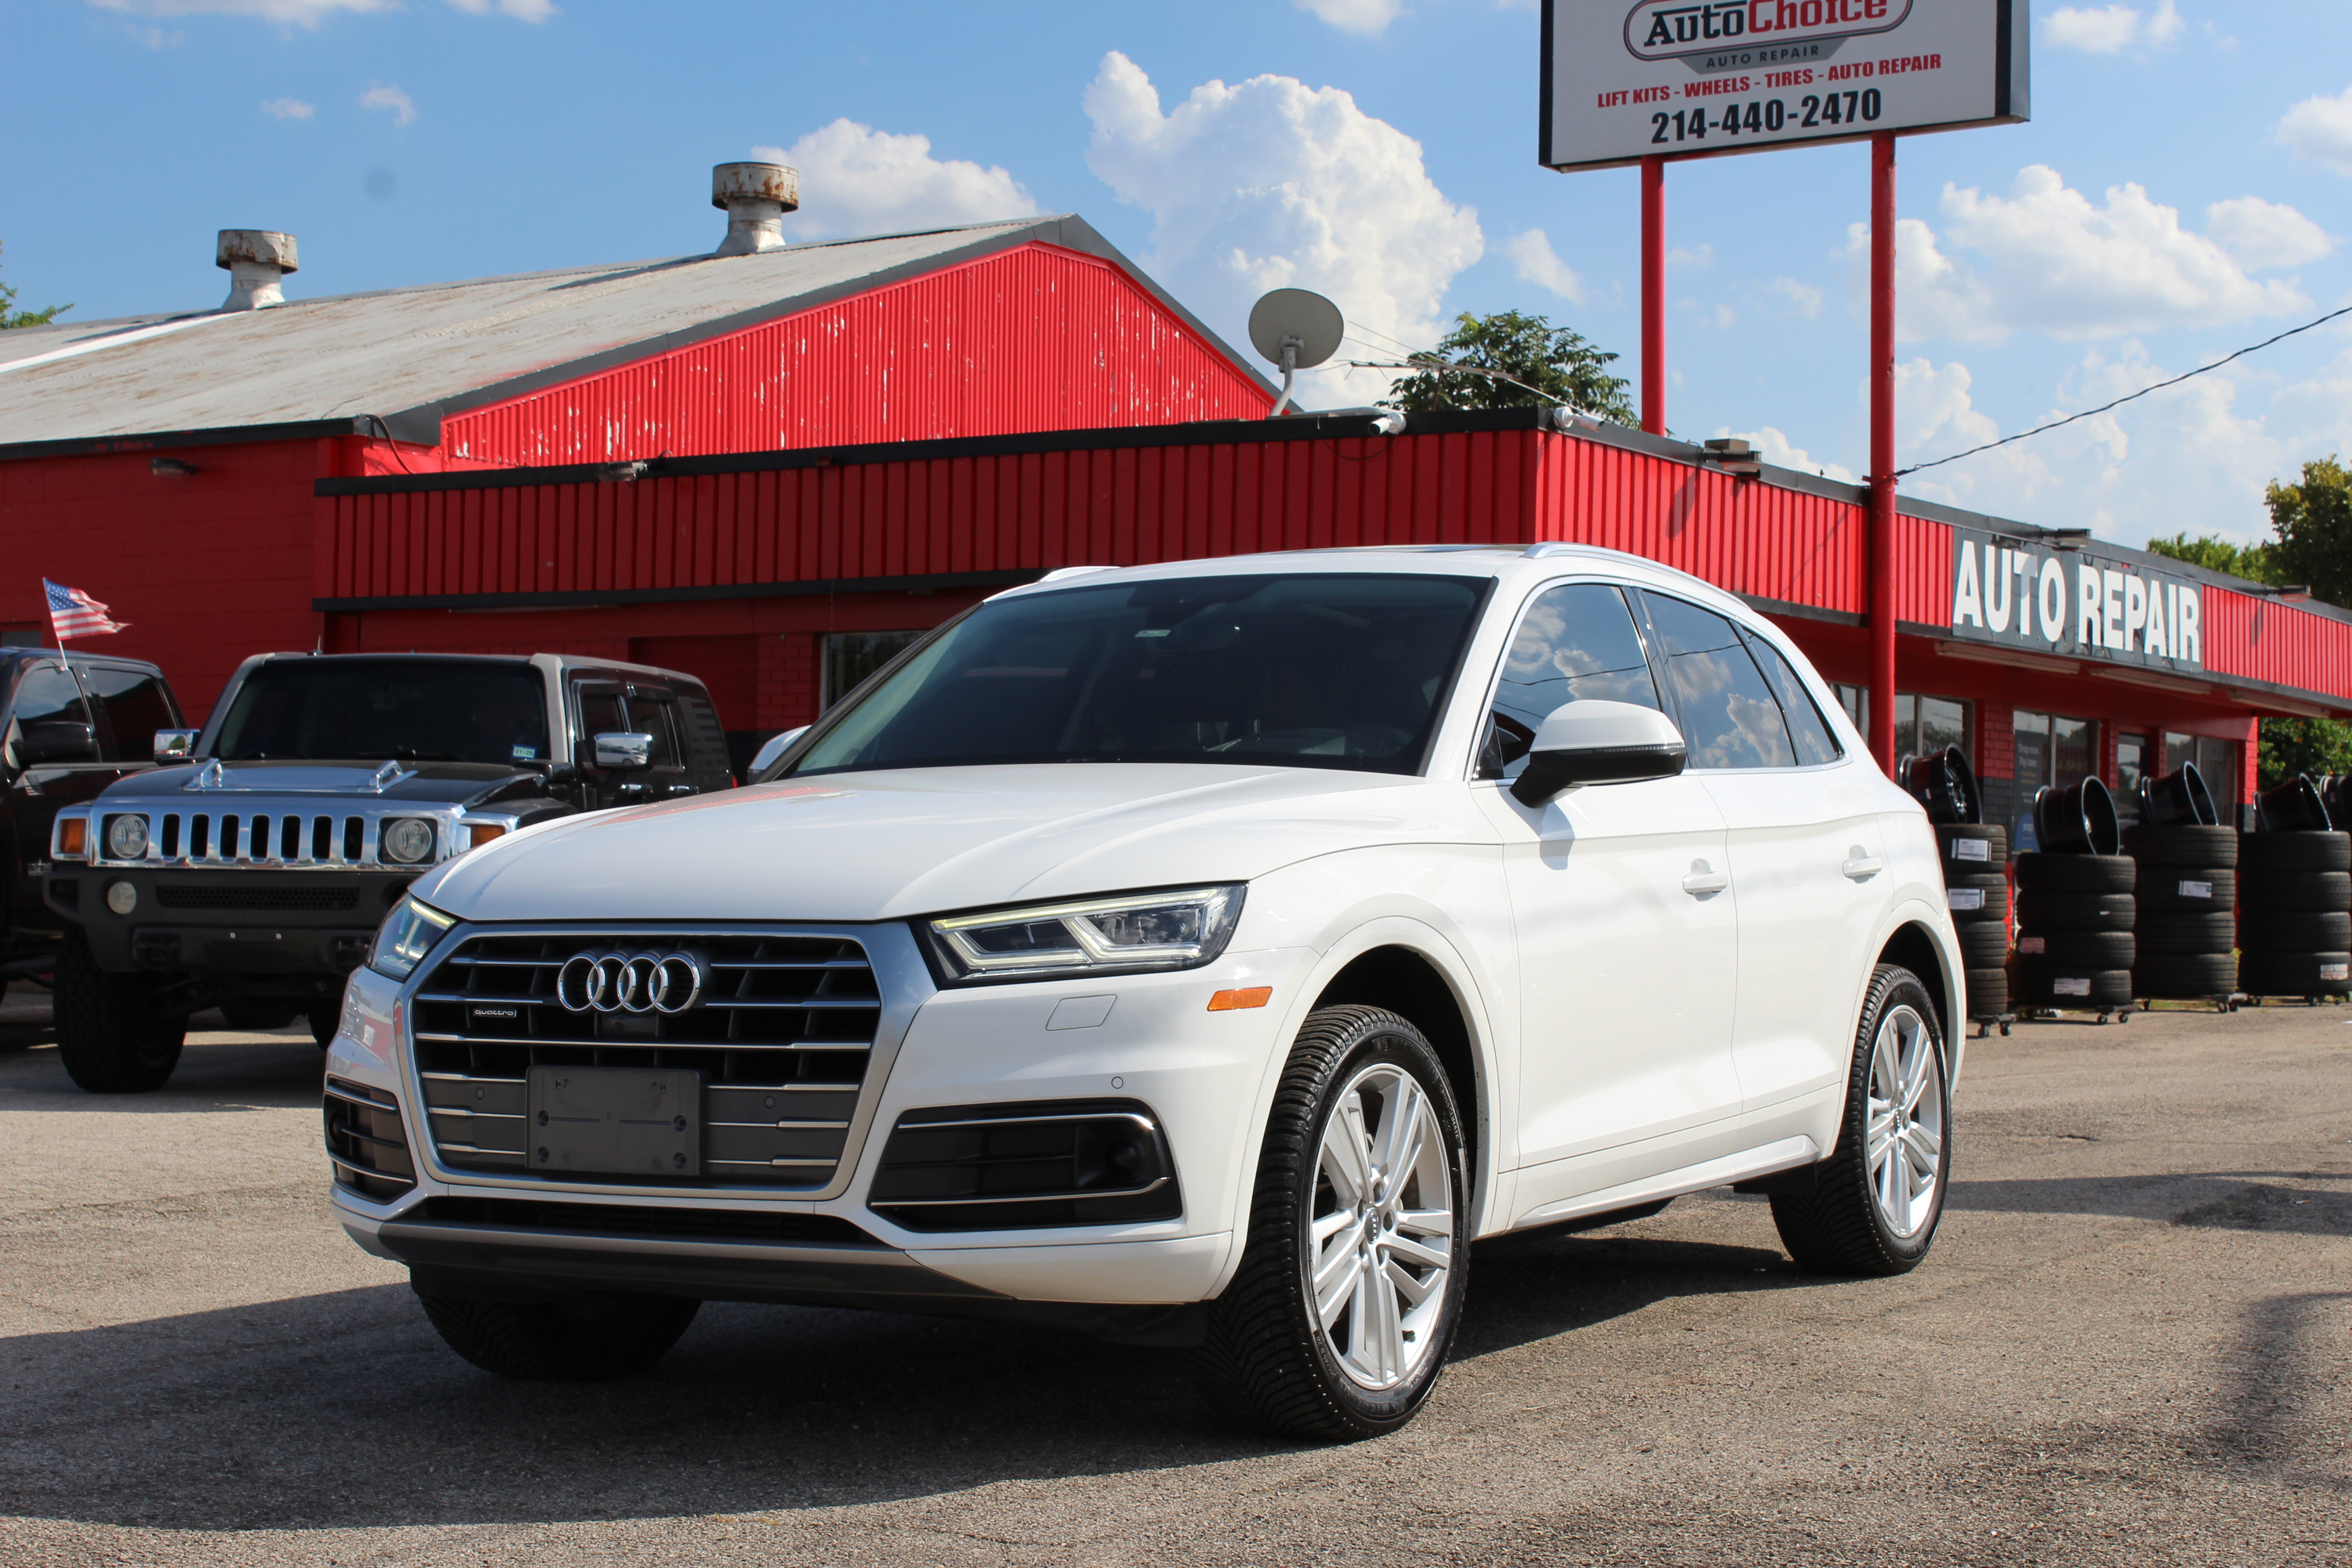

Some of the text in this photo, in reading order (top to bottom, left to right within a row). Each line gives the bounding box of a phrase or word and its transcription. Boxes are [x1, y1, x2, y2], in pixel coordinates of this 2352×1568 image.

[1643, 0, 1887, 46] AutoChoice
[1598, 91, 1629, 108] LIFT
[1633, 85, 1671, 103] KITS
[1684, 76, 1750, 98] WHEELS
[1764, 69, 1813, 88] TIRES
[1828, 61, 1874, 81] AUTO
[1879, 54, 1941, 75] REPAIR
[1706, 45, 1819, 69] AUTO REPAIR
[1651, 88, 1881, 144] 214-440-2470
[1952, 540, 2200, 663] AUTO REPAIR
